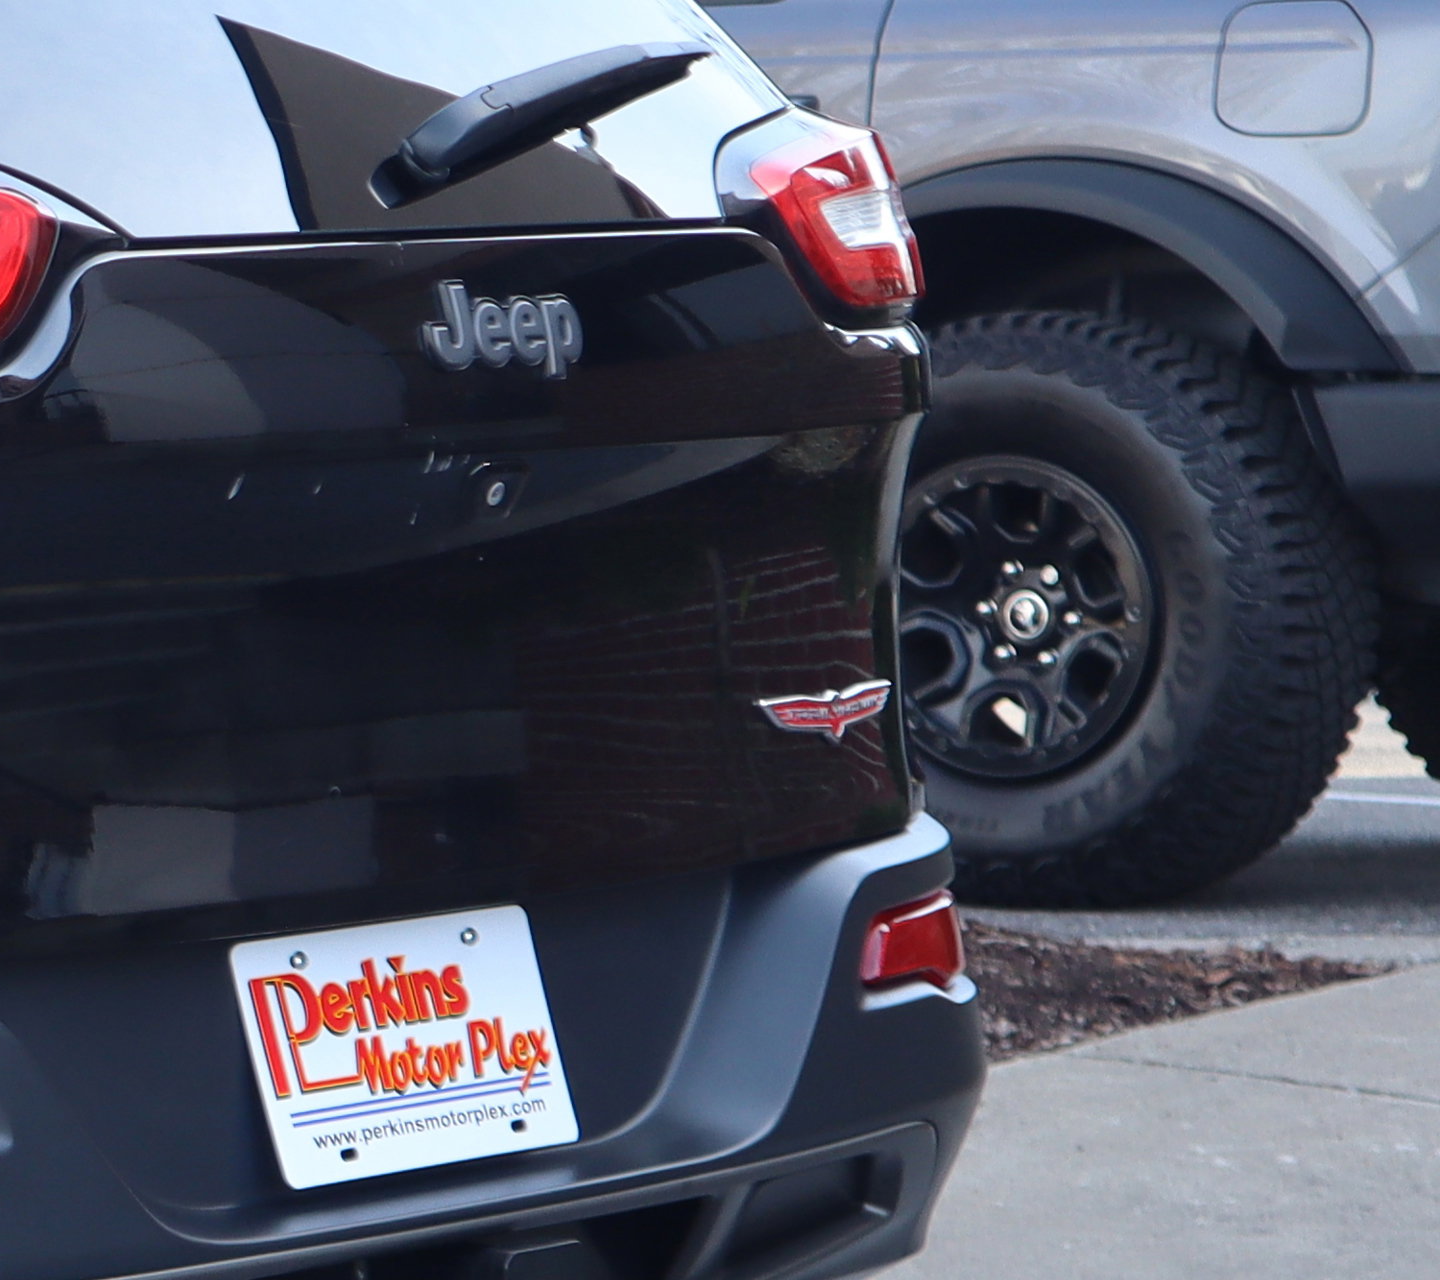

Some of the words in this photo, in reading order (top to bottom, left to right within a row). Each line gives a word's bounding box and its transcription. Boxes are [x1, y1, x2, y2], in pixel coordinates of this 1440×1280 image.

[420, 278, 582, 380] Jeep
[248, 955, 472, 1100] Perkins
[354, 1035, 464, 1096] Motor
[467, 1016, 553, 1096] Plex
[313, 1095, 548, 1150] www.perkinsmotorplex.com
